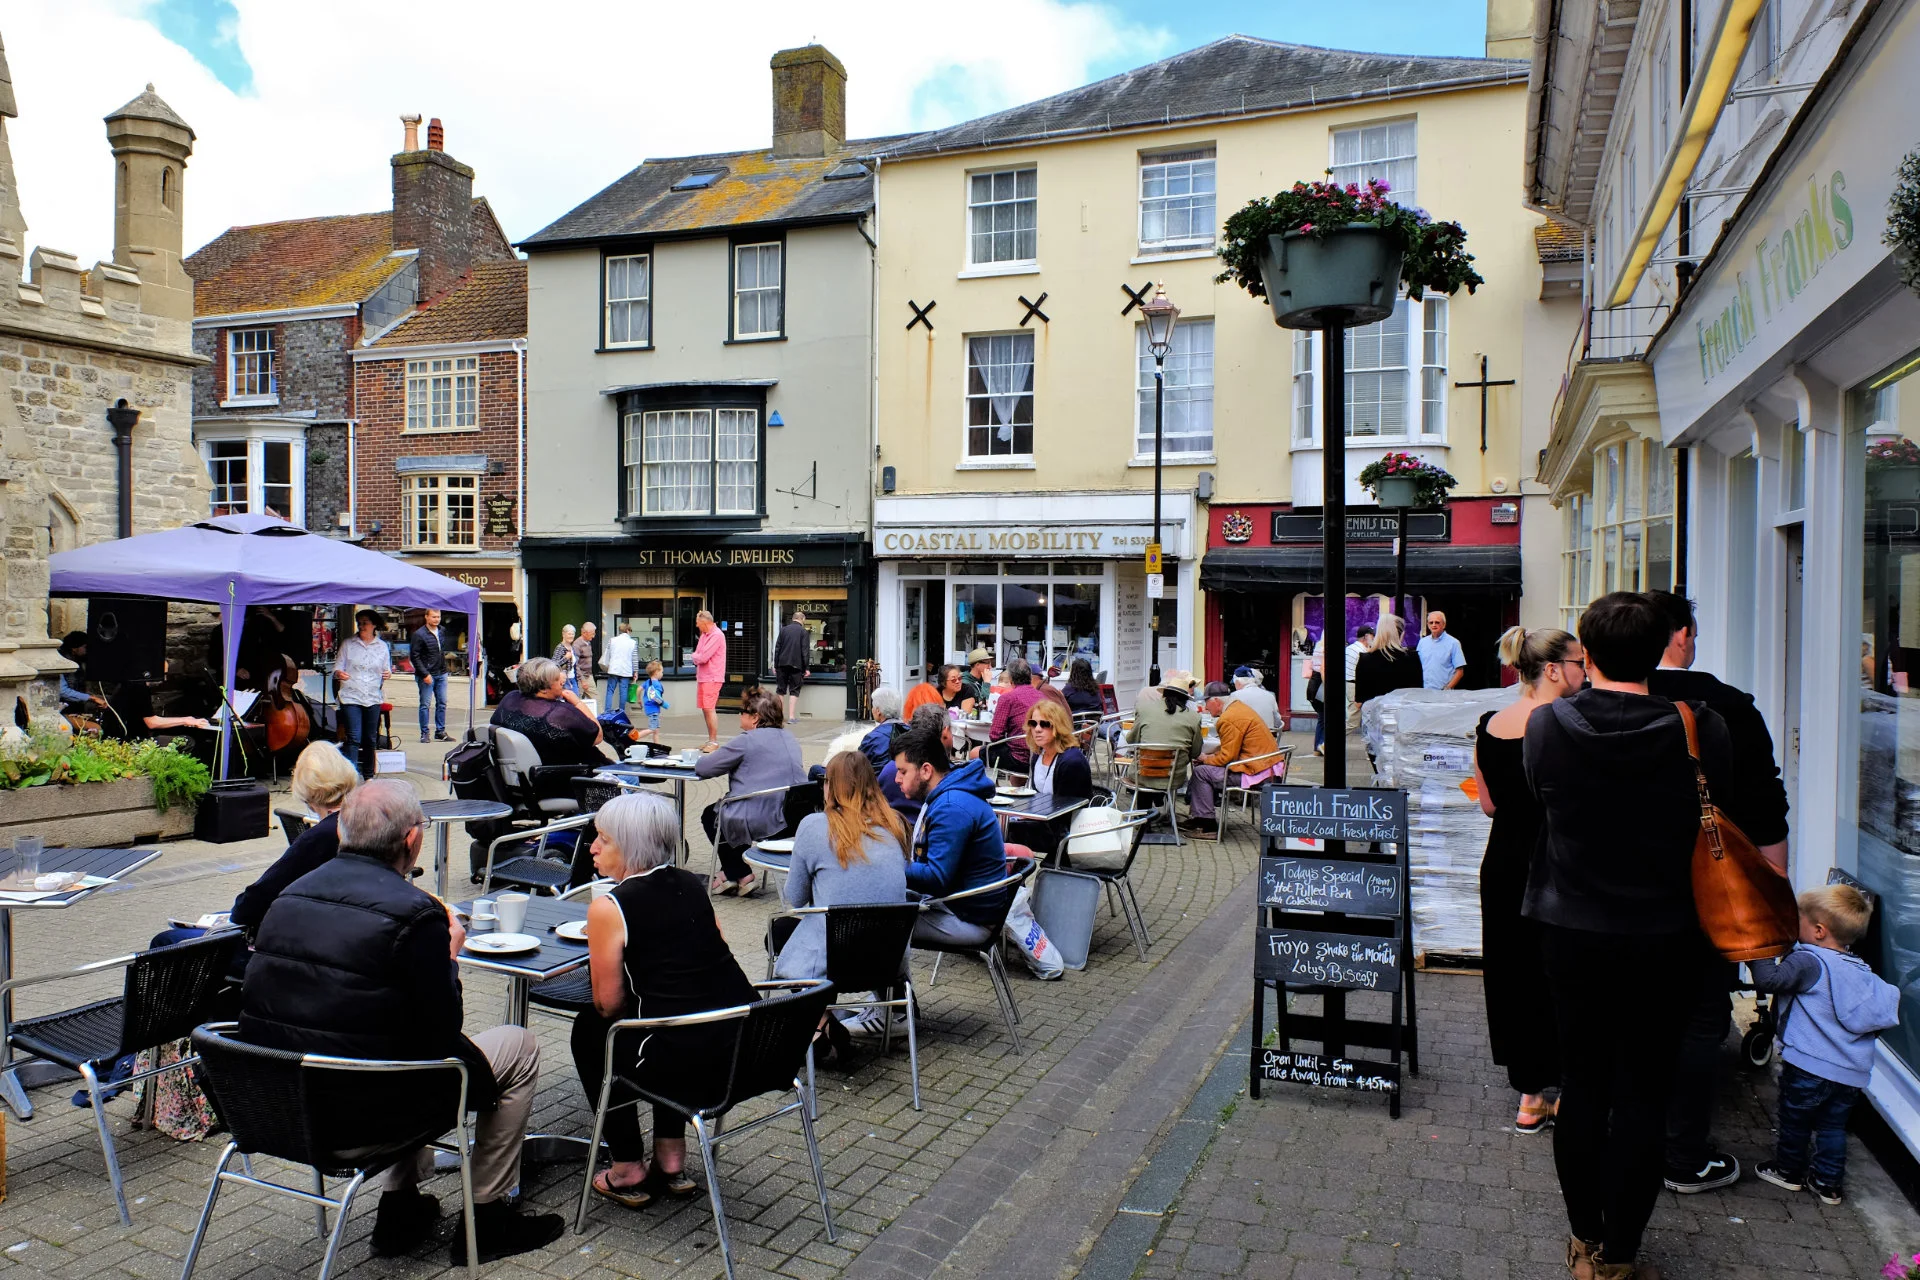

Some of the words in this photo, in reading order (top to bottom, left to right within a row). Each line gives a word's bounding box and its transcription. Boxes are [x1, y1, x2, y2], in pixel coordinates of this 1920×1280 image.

[1696, 271, 1757, 385] French
[1755, 170, 1854, 324] Franks
[1345, 517, 1378, 530] ENNIS
[1380, 517, 1399, 530] LTD
[884, 533, 983, 550] COASTAL
[988, 532, 1104, 550] MOBILITY
[1112, 536, 1128, 546] Tel
[639, 550, 656, 565] ST
[661, 550, 722, 565] THOMAS
[727, 549, 794, 566] JEWELLERS
[459, 573, 489, 588] Shop
[796, 603, 829, 613] ROLEX
[1270, 791, 1323, 816] French
[1263, 817, 1285, 834] Real
[1312, 822, 1338, 837] Local
[1340, 822, 1368, 840] Fresh
[1374, 824, 1400, 840] Fast
[1275, 861, 1319, 885] Today's
[1322, 866, 1365, 886] Special
[1273, 881, 1294, 899] Hot
[1294, 883, 1328, 898] Pulled
[1330, 885, 1354, 900] Pork
[1268, 934, 1310, 959] Froyo
[1315, 942, 1349, 958] Shake
[1351, 942, 1362, 953] of
[1351, 952, 1365, 962] the
[1291, 959, 1327, 981] Lotus
[1326, 962, 1379, 988] Biscoff
[1263, 1050, 1291, 1066] Open
[1294, 1054, 1319, 1071] Until
[1260, 1064, 1287, 1080] Take
[1290, 1068, 1321, 1086] Away
[1323, 1071, 1348, 1088] from
